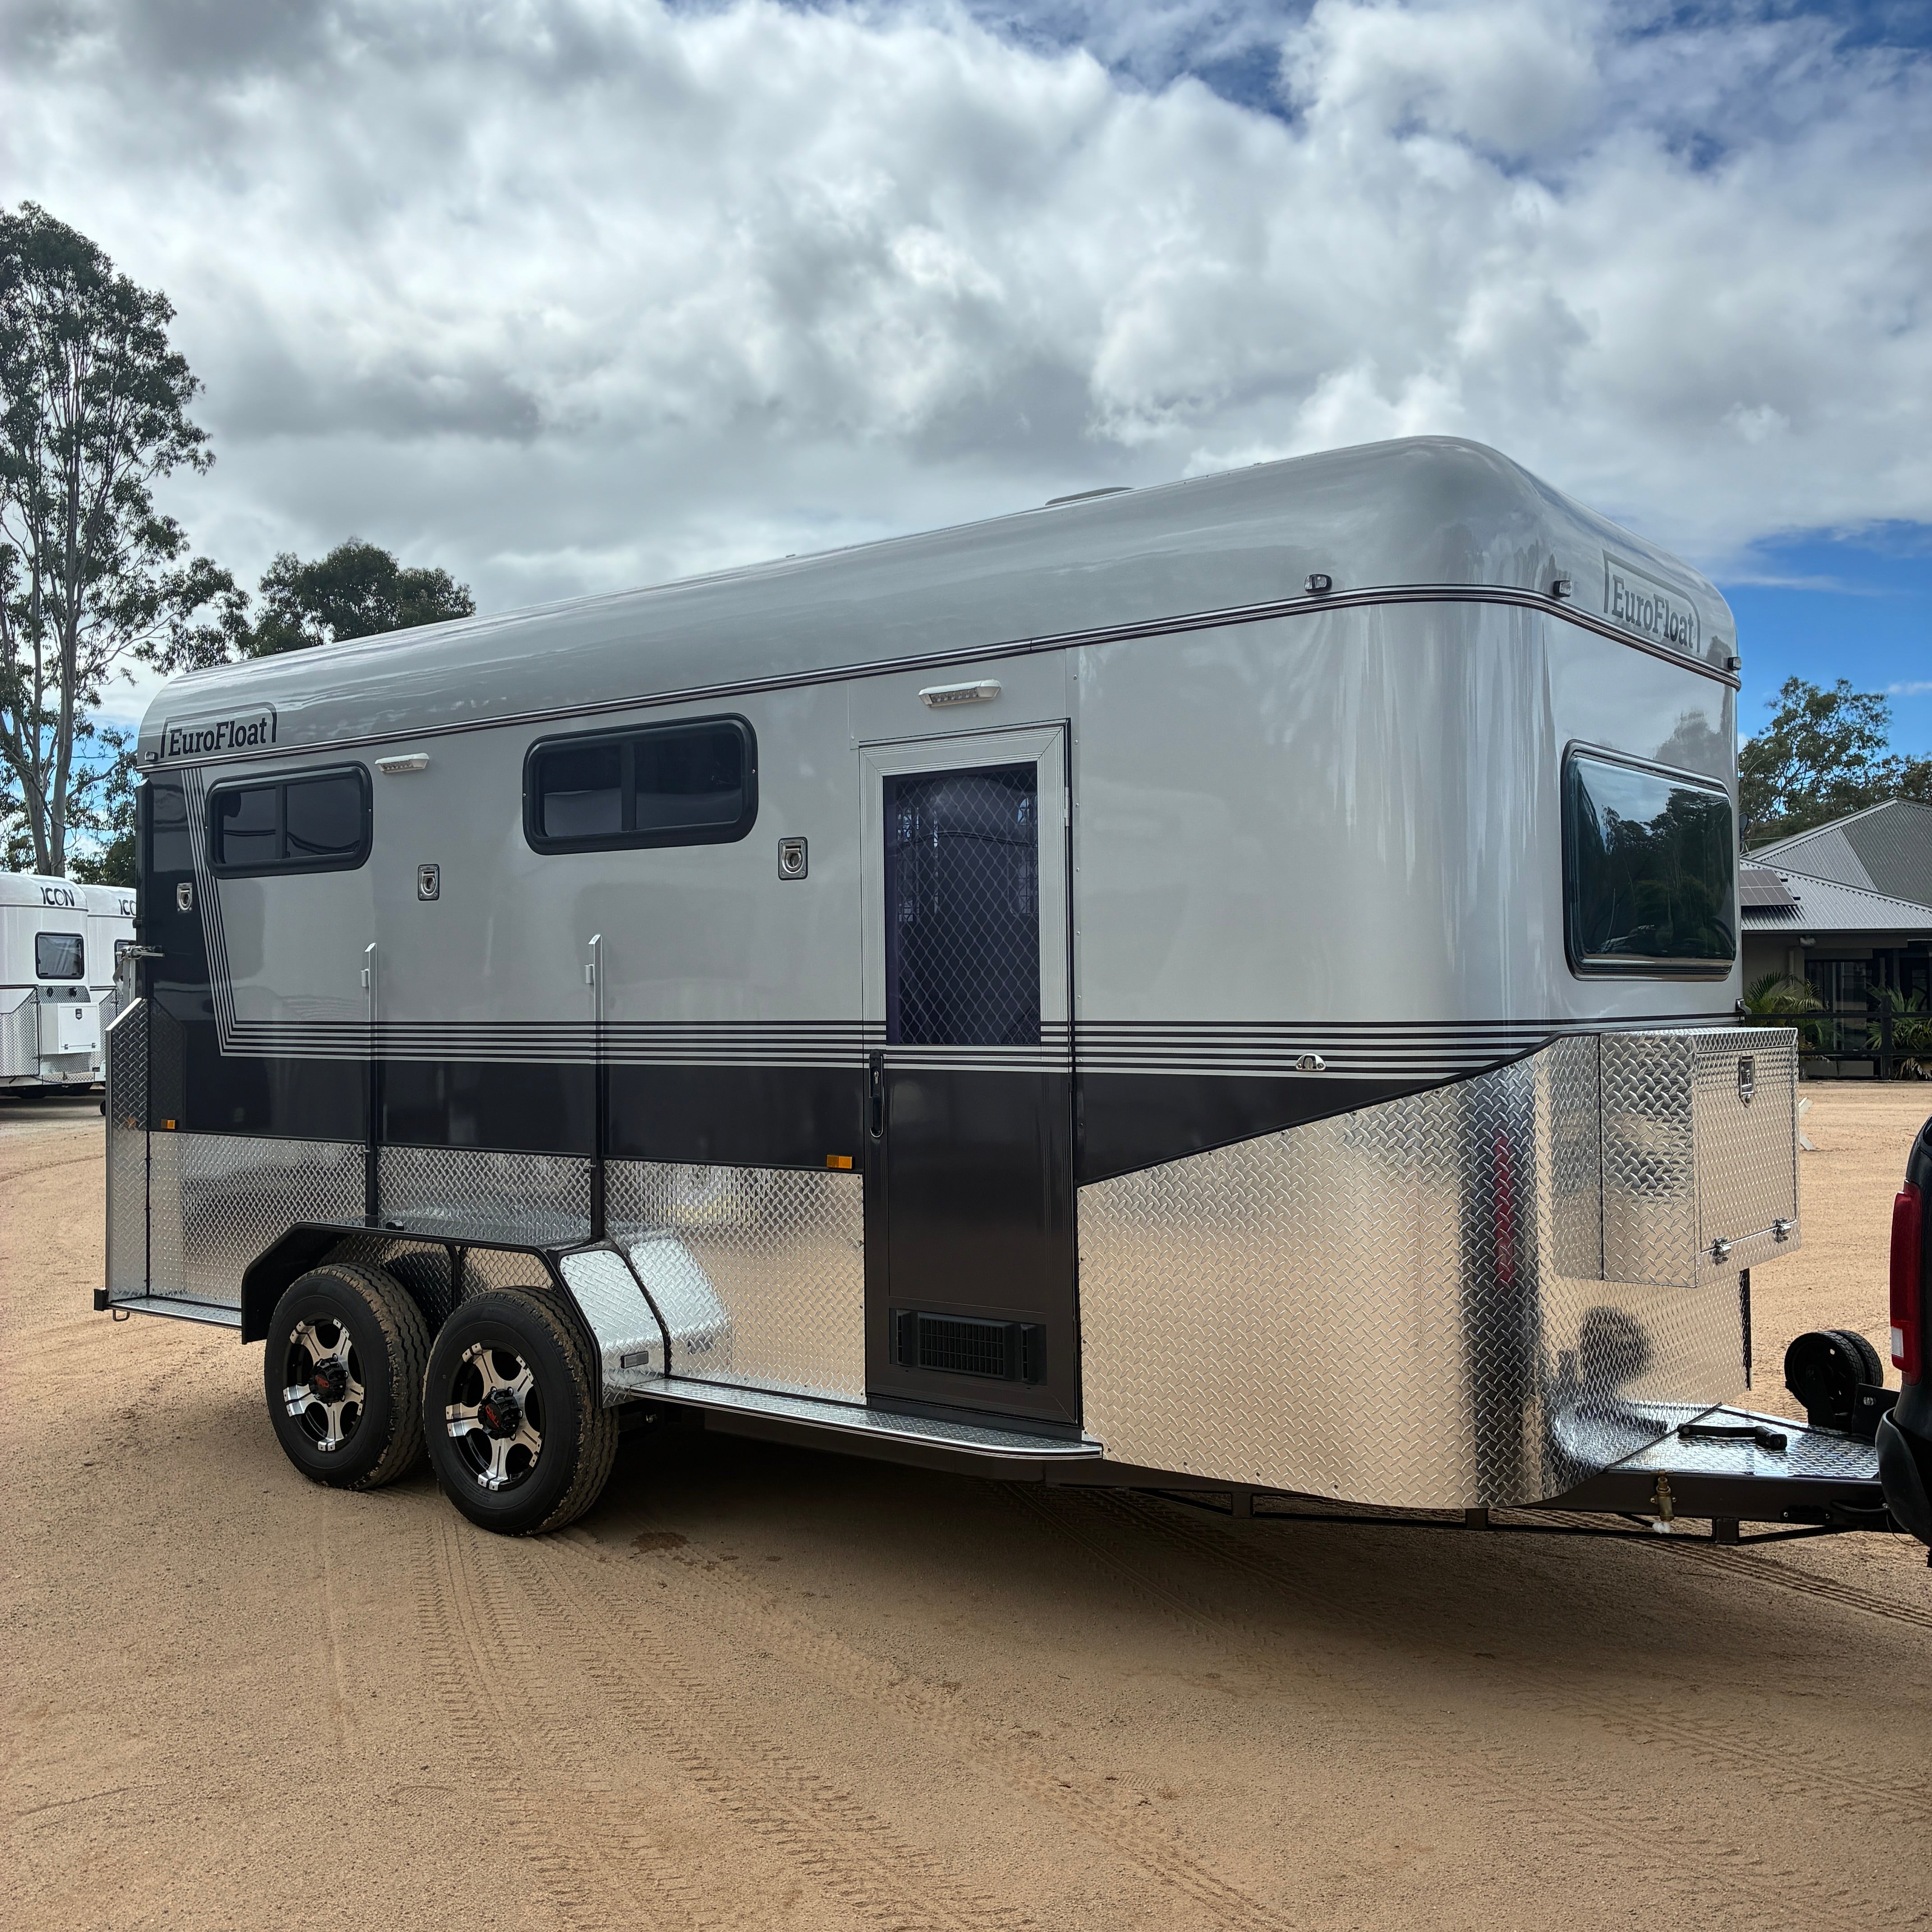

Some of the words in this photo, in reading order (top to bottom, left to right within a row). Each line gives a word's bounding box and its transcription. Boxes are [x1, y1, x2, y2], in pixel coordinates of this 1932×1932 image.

[1612, 574, 1694, 649] EuroFloat
[168, 718, 267, 756] EuroFloat
[40, 887, 75, 906] ICON
[118, 899, 137, 916] ICO
